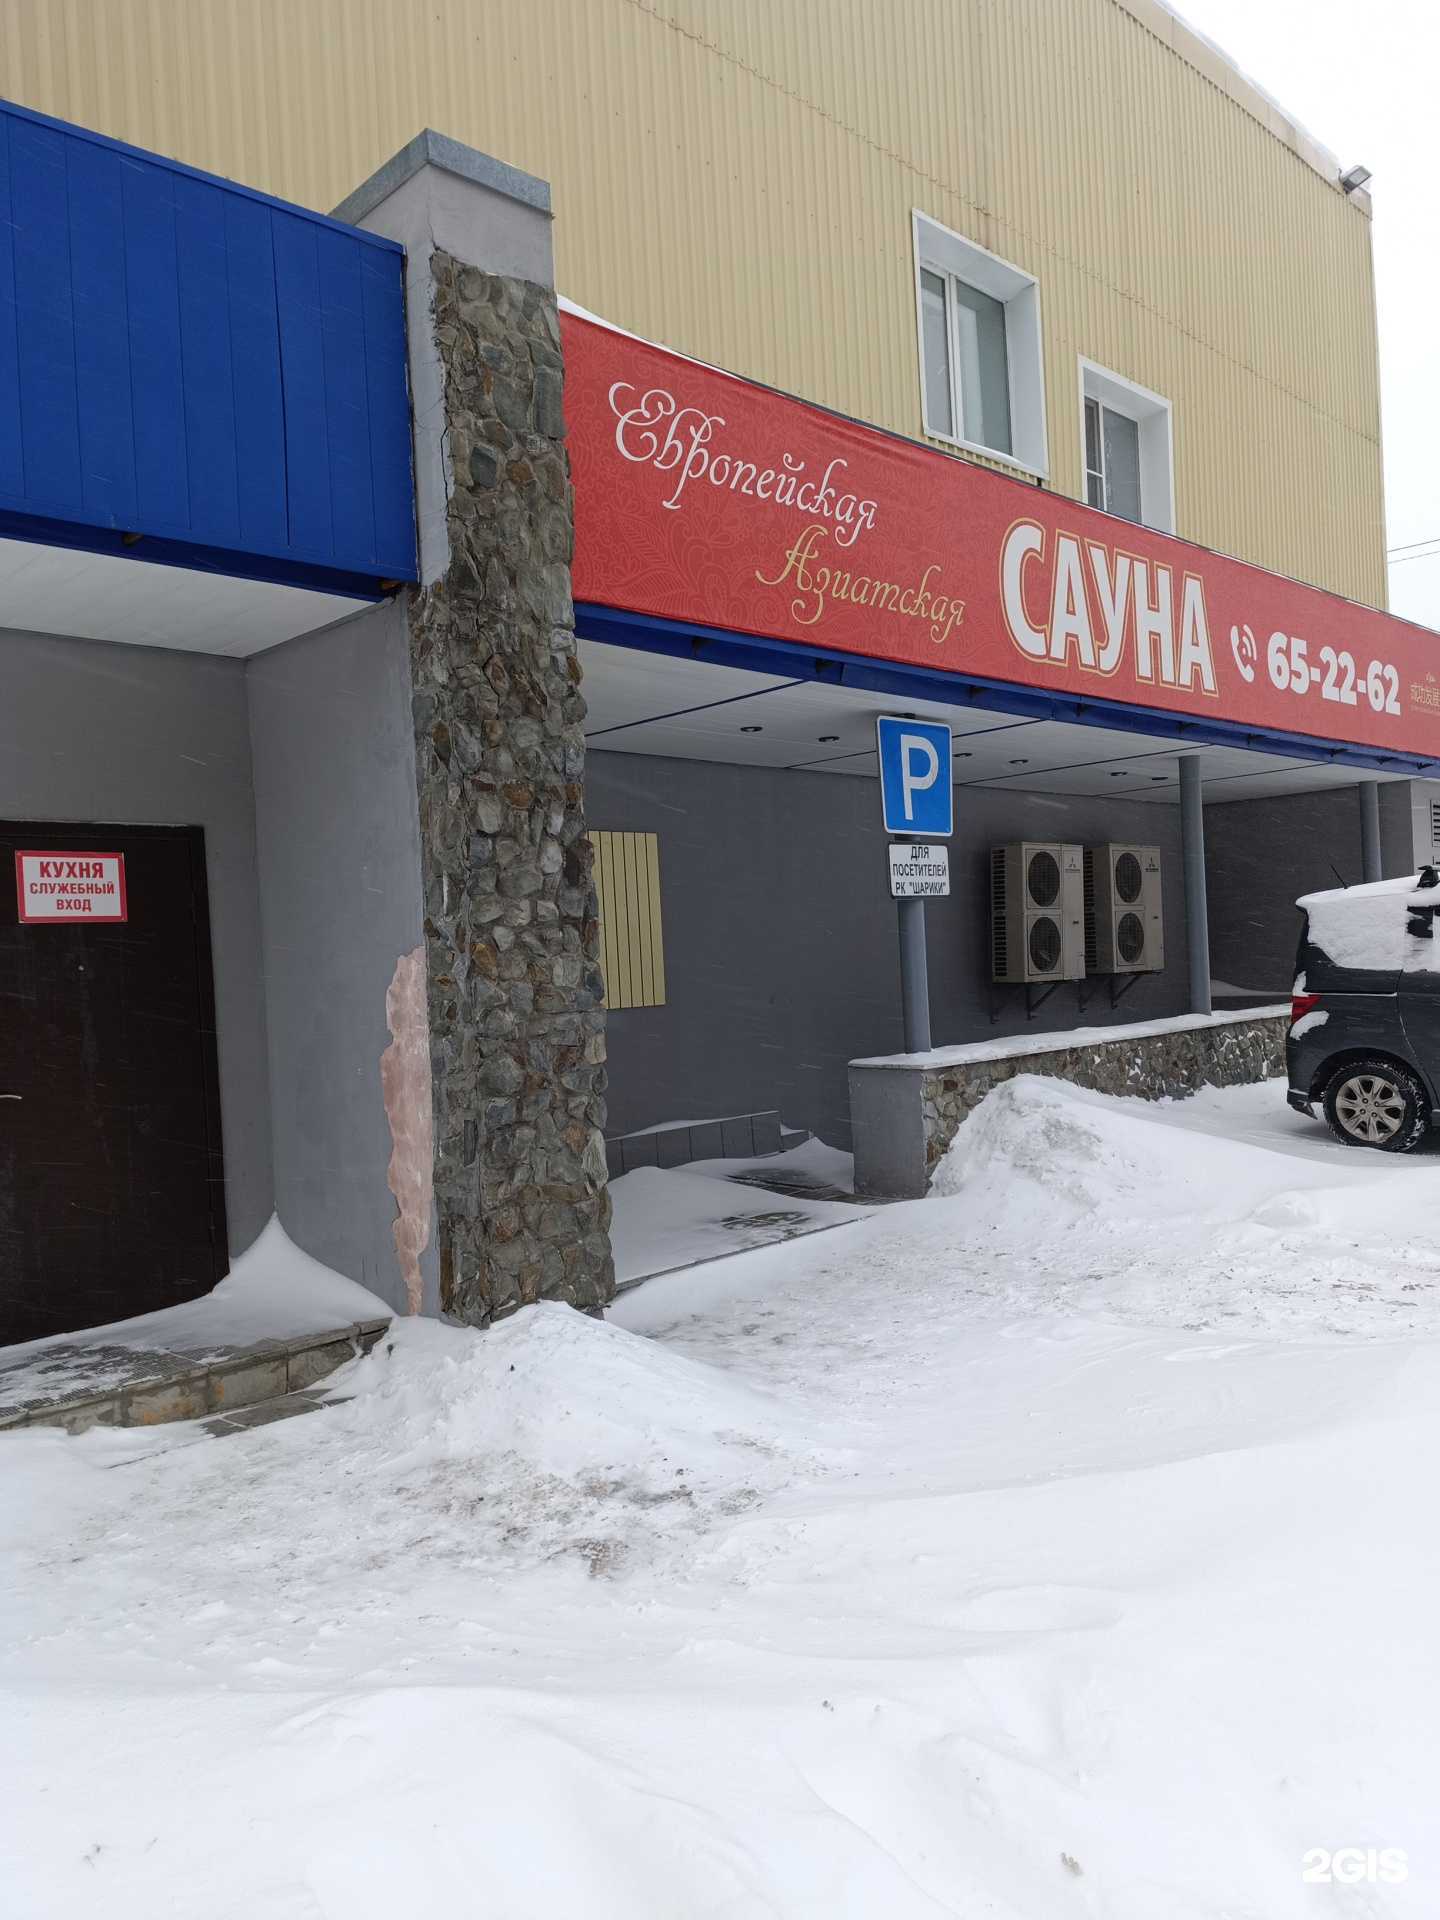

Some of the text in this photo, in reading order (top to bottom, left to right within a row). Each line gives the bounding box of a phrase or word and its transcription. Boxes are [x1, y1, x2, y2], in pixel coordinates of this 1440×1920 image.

[608, 381, 880, 547] Европейская
[755, 524, 967, 644] Азиатская
[1001, 519, 1218, 697] САУНА
[1267, 631, 1401, 717] 65-22-62
[900, 734, 939, 821] P
[910, 845, 930, 861] ДЛЯ
[39, 861, 104, 879] КУХНЯ
[892, 861, 947, 877] ПОСЕТИТЕЛЕЙ
[29, 881, 115, 895] СЛУЖЕБНЫЙ
[895, 881, 947, 895] РК "ШАРИКИ"
[56, 899, 92, 913] ВХОД
